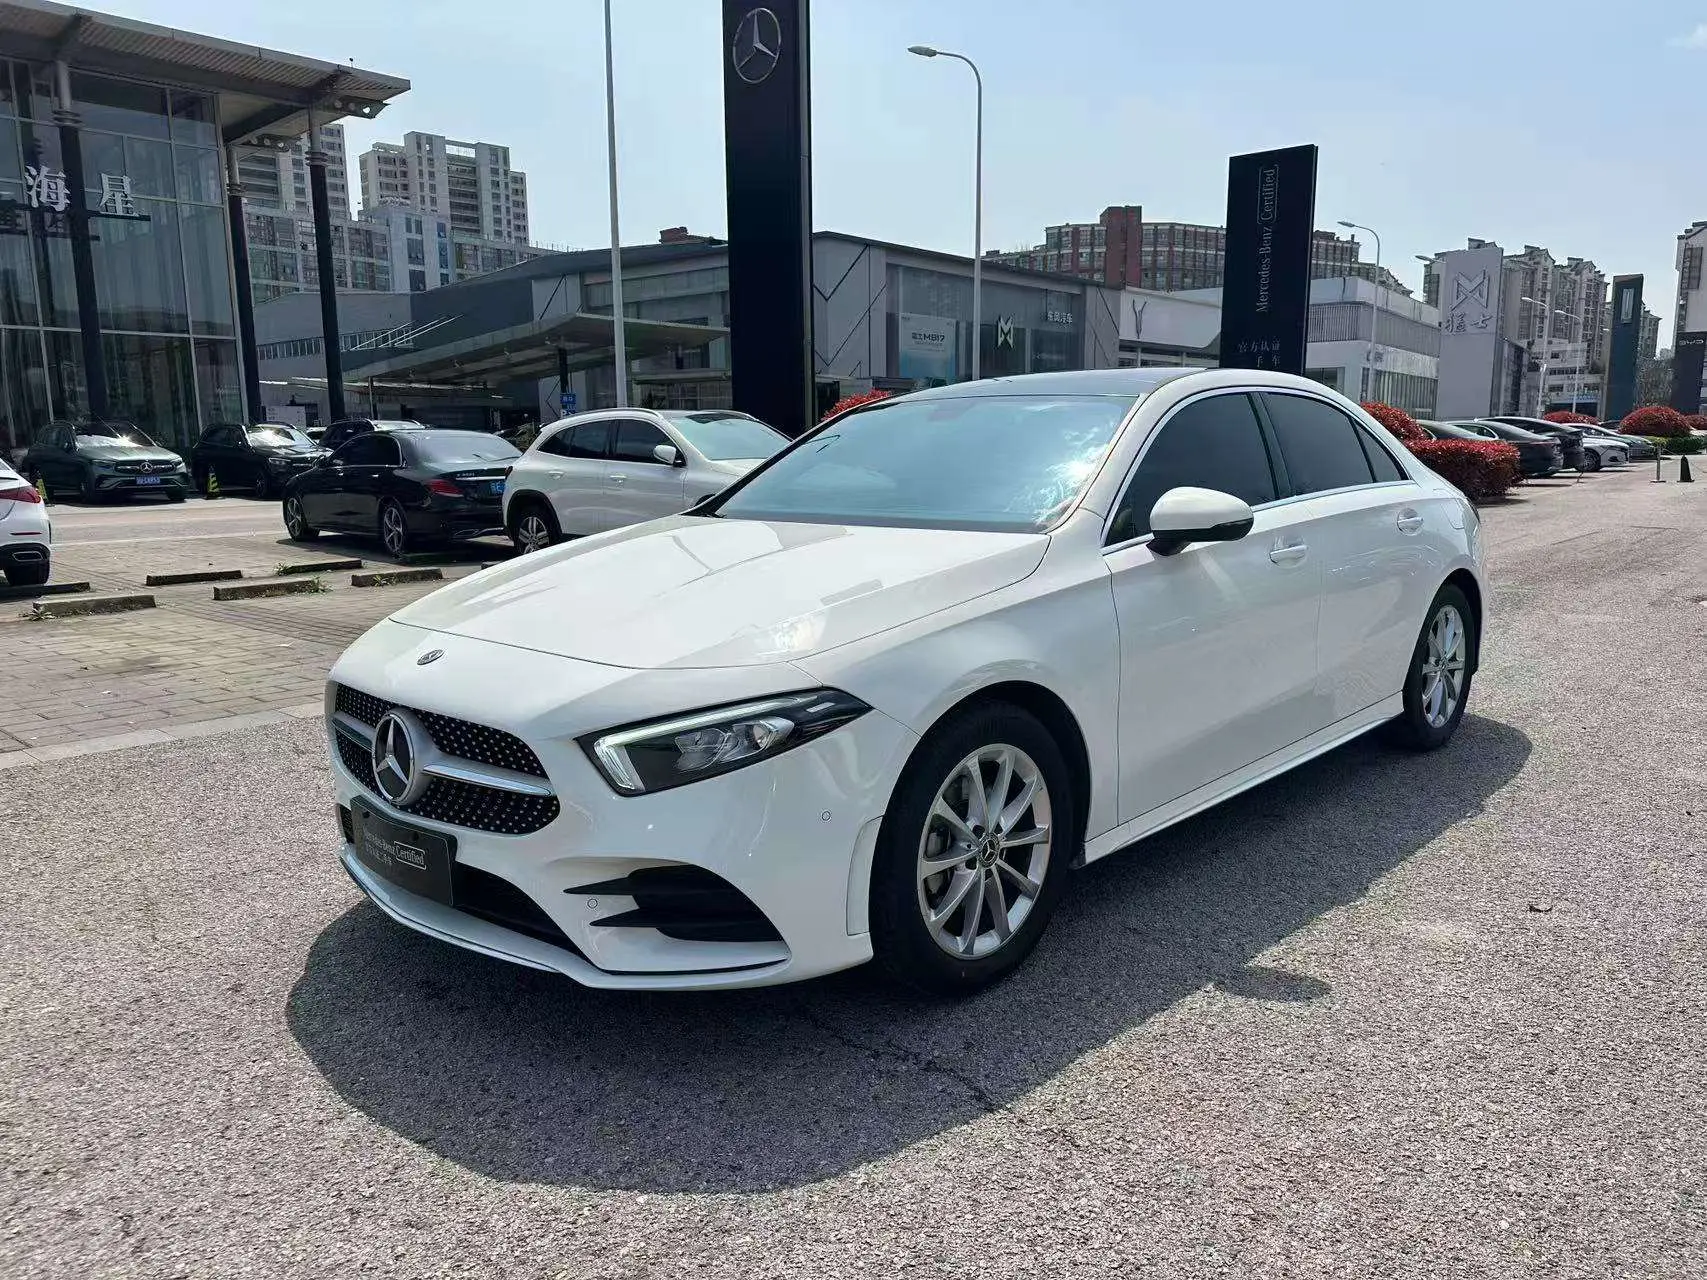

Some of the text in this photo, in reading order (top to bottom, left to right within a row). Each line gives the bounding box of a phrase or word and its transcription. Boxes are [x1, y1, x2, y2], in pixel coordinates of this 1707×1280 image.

[25, 165, 139, 217] 海星
[1255, 168, 1276, 313] Mercedes-Benz Certified
[396, 845, 425, 865] Certified
